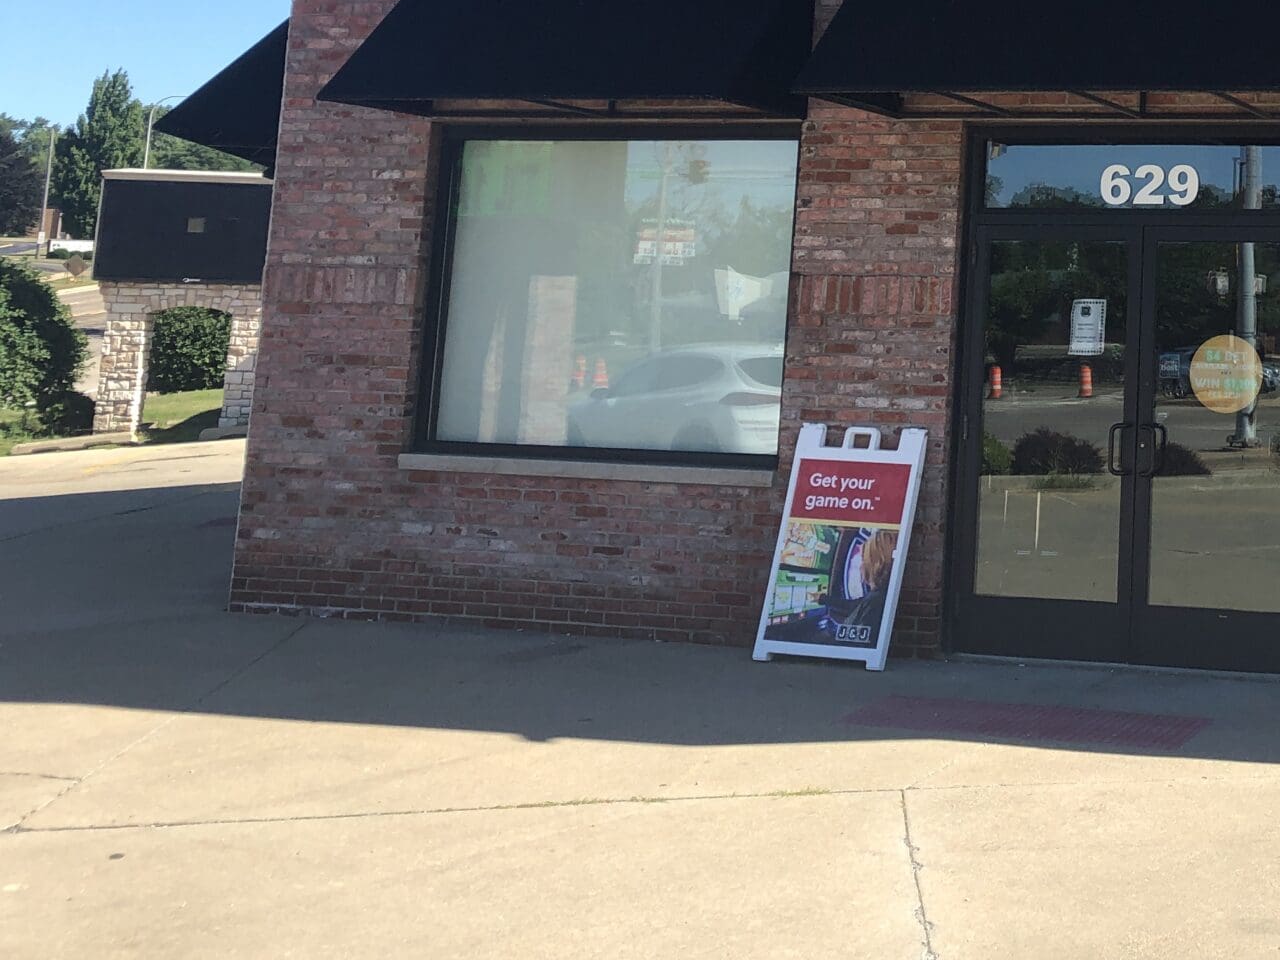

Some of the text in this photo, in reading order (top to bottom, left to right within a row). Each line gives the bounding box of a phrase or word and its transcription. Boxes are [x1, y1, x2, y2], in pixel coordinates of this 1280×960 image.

[1099, 164, 1200, 206] 629
[809, 472, 876, 492] Get your
[804, 495, 849, 510] game
